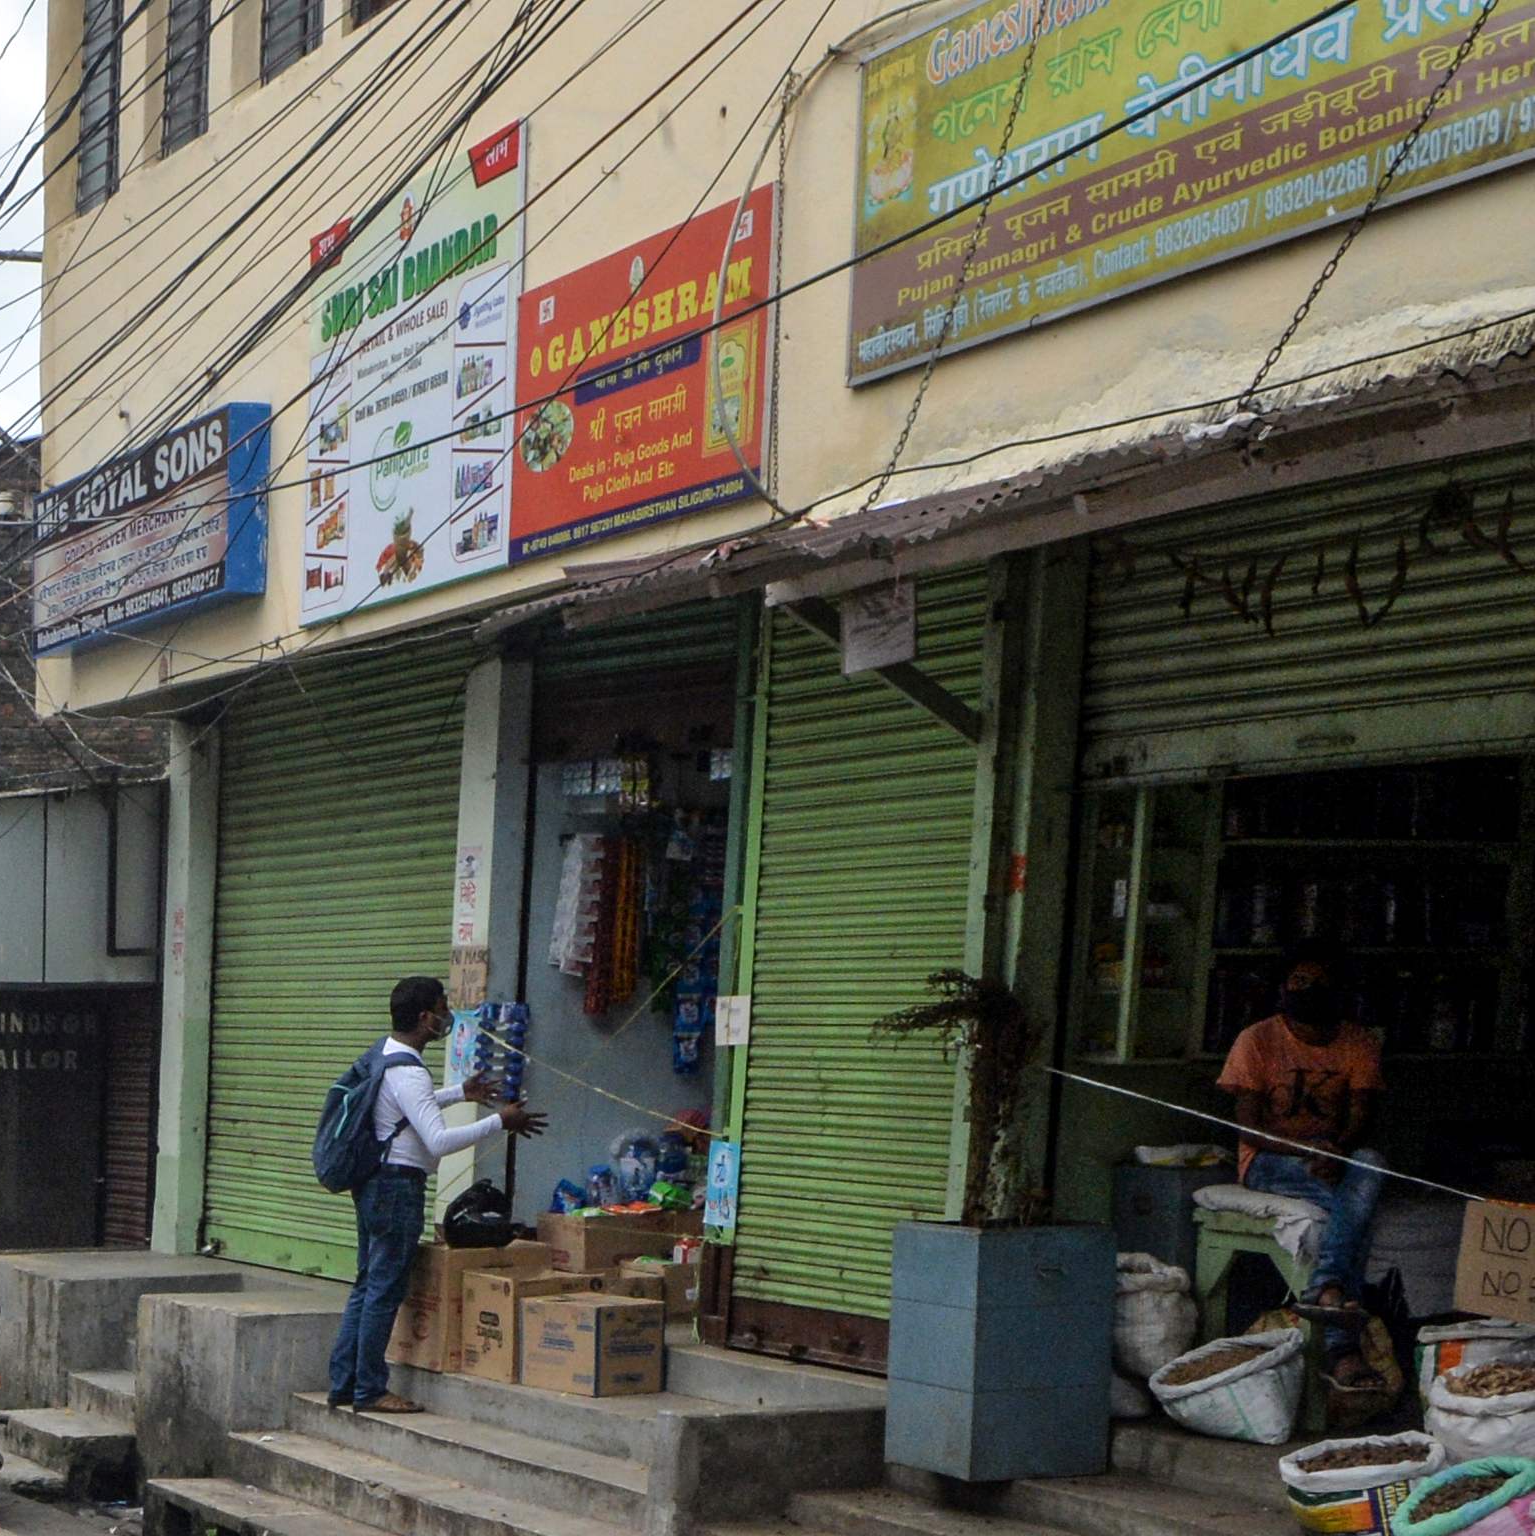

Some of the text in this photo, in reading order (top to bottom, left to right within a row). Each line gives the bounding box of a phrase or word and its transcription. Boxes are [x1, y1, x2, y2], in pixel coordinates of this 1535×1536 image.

[897, 272, 955, 308] Pujan
[963, 232, 1058, 284] Samagri
[1065, 223, 1083, 245] &
[1090, 193, 1164, 236] Crude
[1173, 141, 1308, 207] Ayurvedic
[1318, 79, 1464, 152] Botanical
[1004, 195, 1072, 237] पूजन
[1085, 150, 1178, 203] सामग्री
[1194, 121, 1244, 165] एवं
[1155, 197, 1251, 258] 9832054037
[1264, 154, 1369, 221] 9832042266
[367, 262, 399, 320] SAI
[402, 213, 499, 303] BHANDAR
[395, 309, 425, 338] WHOLE
[426, 298, 449, 324] SALE)
[547, 256, 753, 373] GANESHRAM
[154, 418, 223, 492] SONS
[613, 450, 636, 470] Puja
[637, 436, 670, 462] Goods
[671, 427, 693, 450] And
[605, 472, 631, 495] Cloth
[632, 464, 654, 487] And
[129, 502, 188, 539] MERCHANTS
[1481, 1215, 1531, 1253] NO
[1481, 1270, 1522, 1297] NO
